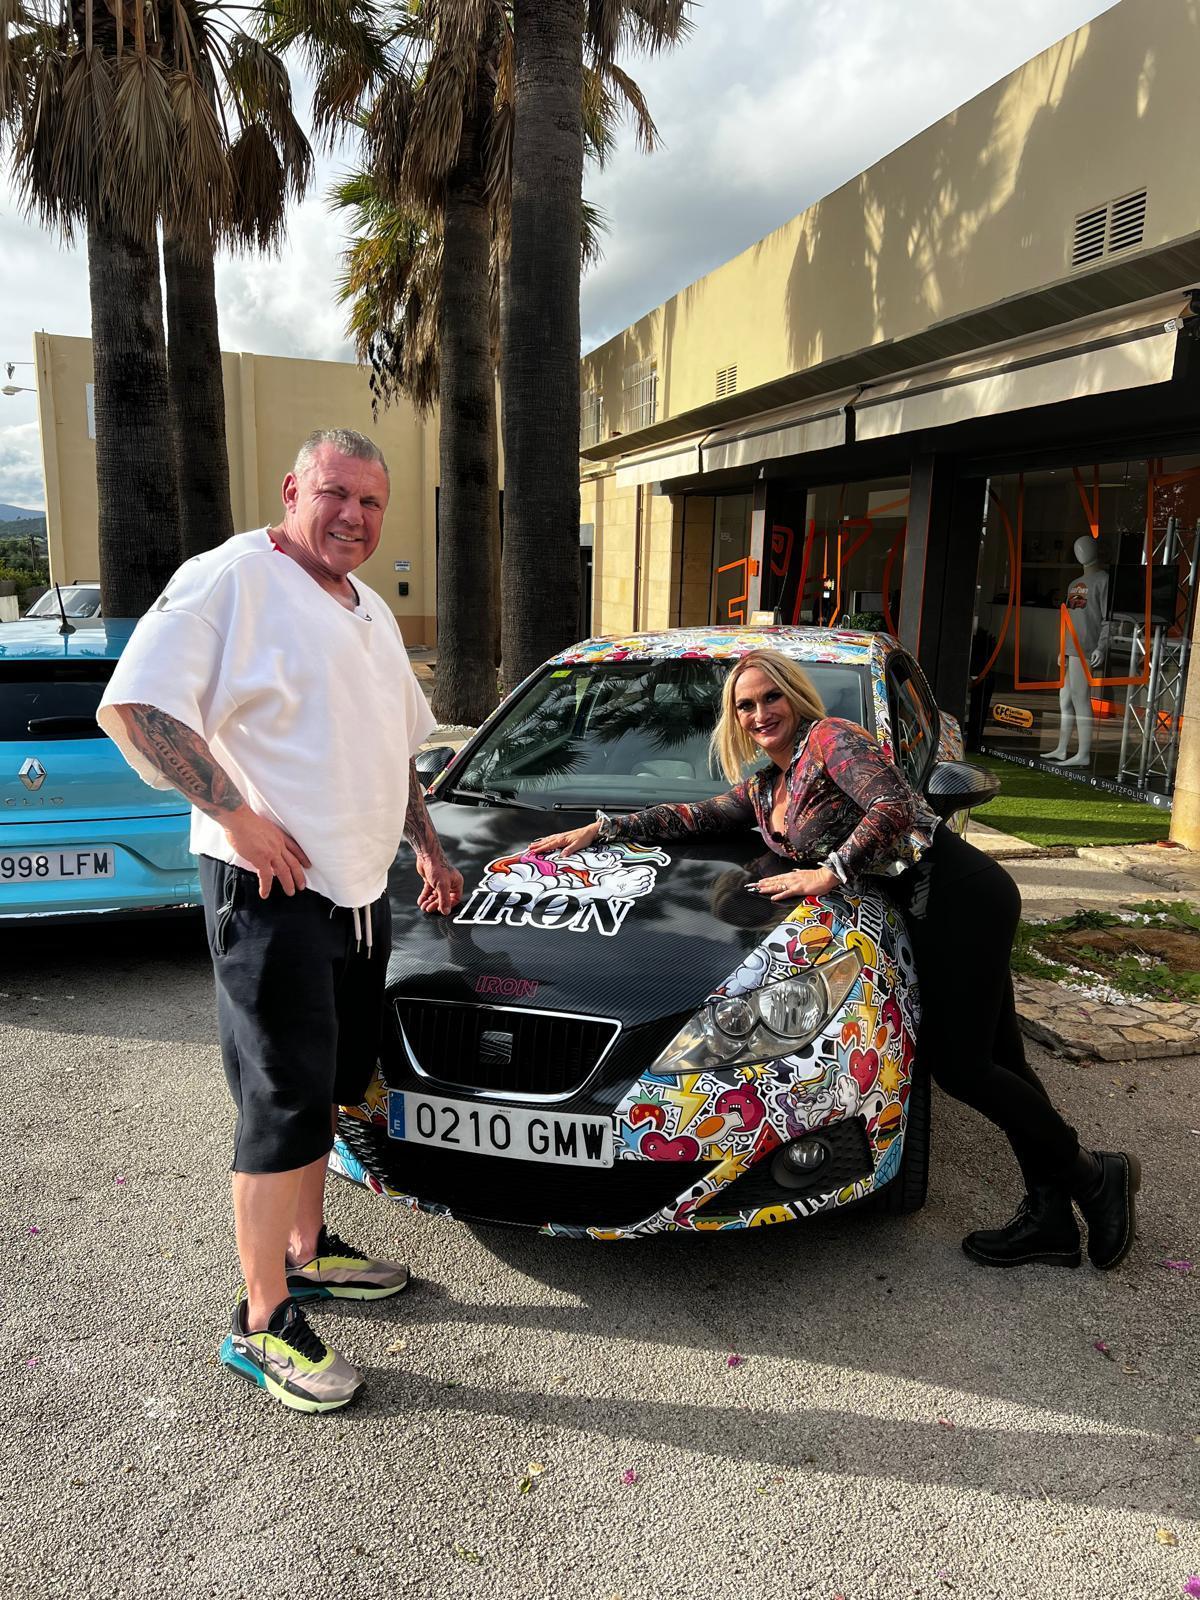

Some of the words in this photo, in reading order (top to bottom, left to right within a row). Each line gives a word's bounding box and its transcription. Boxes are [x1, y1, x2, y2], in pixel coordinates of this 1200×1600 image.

[988, 748, 1026, 765] FIRMENAUTOS
[1039, 763, 1087, 782] TEILFOLIERUNG
[1101, 780, 1149, 801] SHUTZFOLIEN
[5, 796, 65, 807] CLIO
[60, 852, 108, 876] LFM
[455, 889, 634, 936] IRON
[475, 975, 539, 998] IRON
[394, 1119, 401, 1130] E
[416, 1102, 511, 1150] 0210
[527, 1118, 605, 1160] GMW
